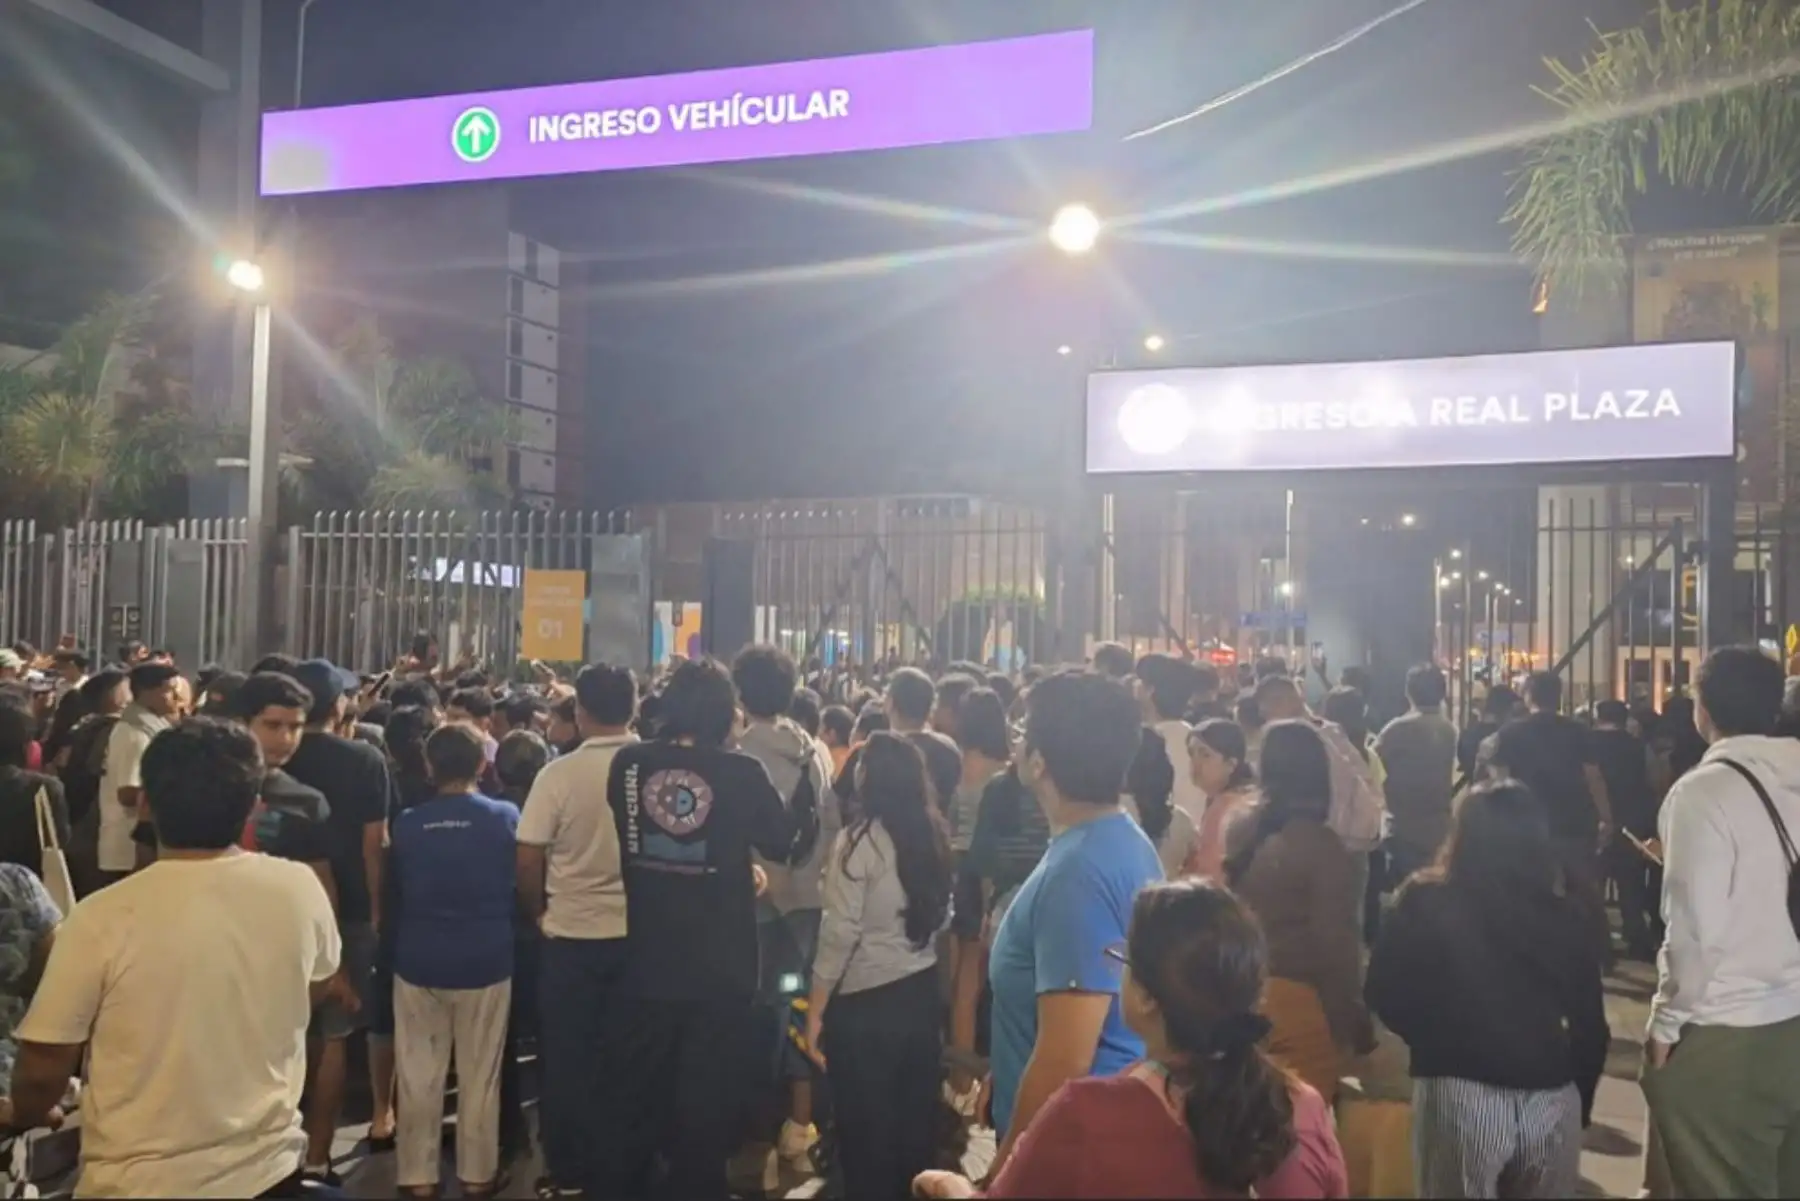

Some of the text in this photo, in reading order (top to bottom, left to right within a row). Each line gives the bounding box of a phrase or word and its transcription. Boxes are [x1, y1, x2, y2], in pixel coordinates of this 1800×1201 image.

[529, 89, 850, 143] INGRESO VEHÍCULAR
[1430, 393, 1531, 427] REAL
[1544, 387, 1682, 423] PLAZA
